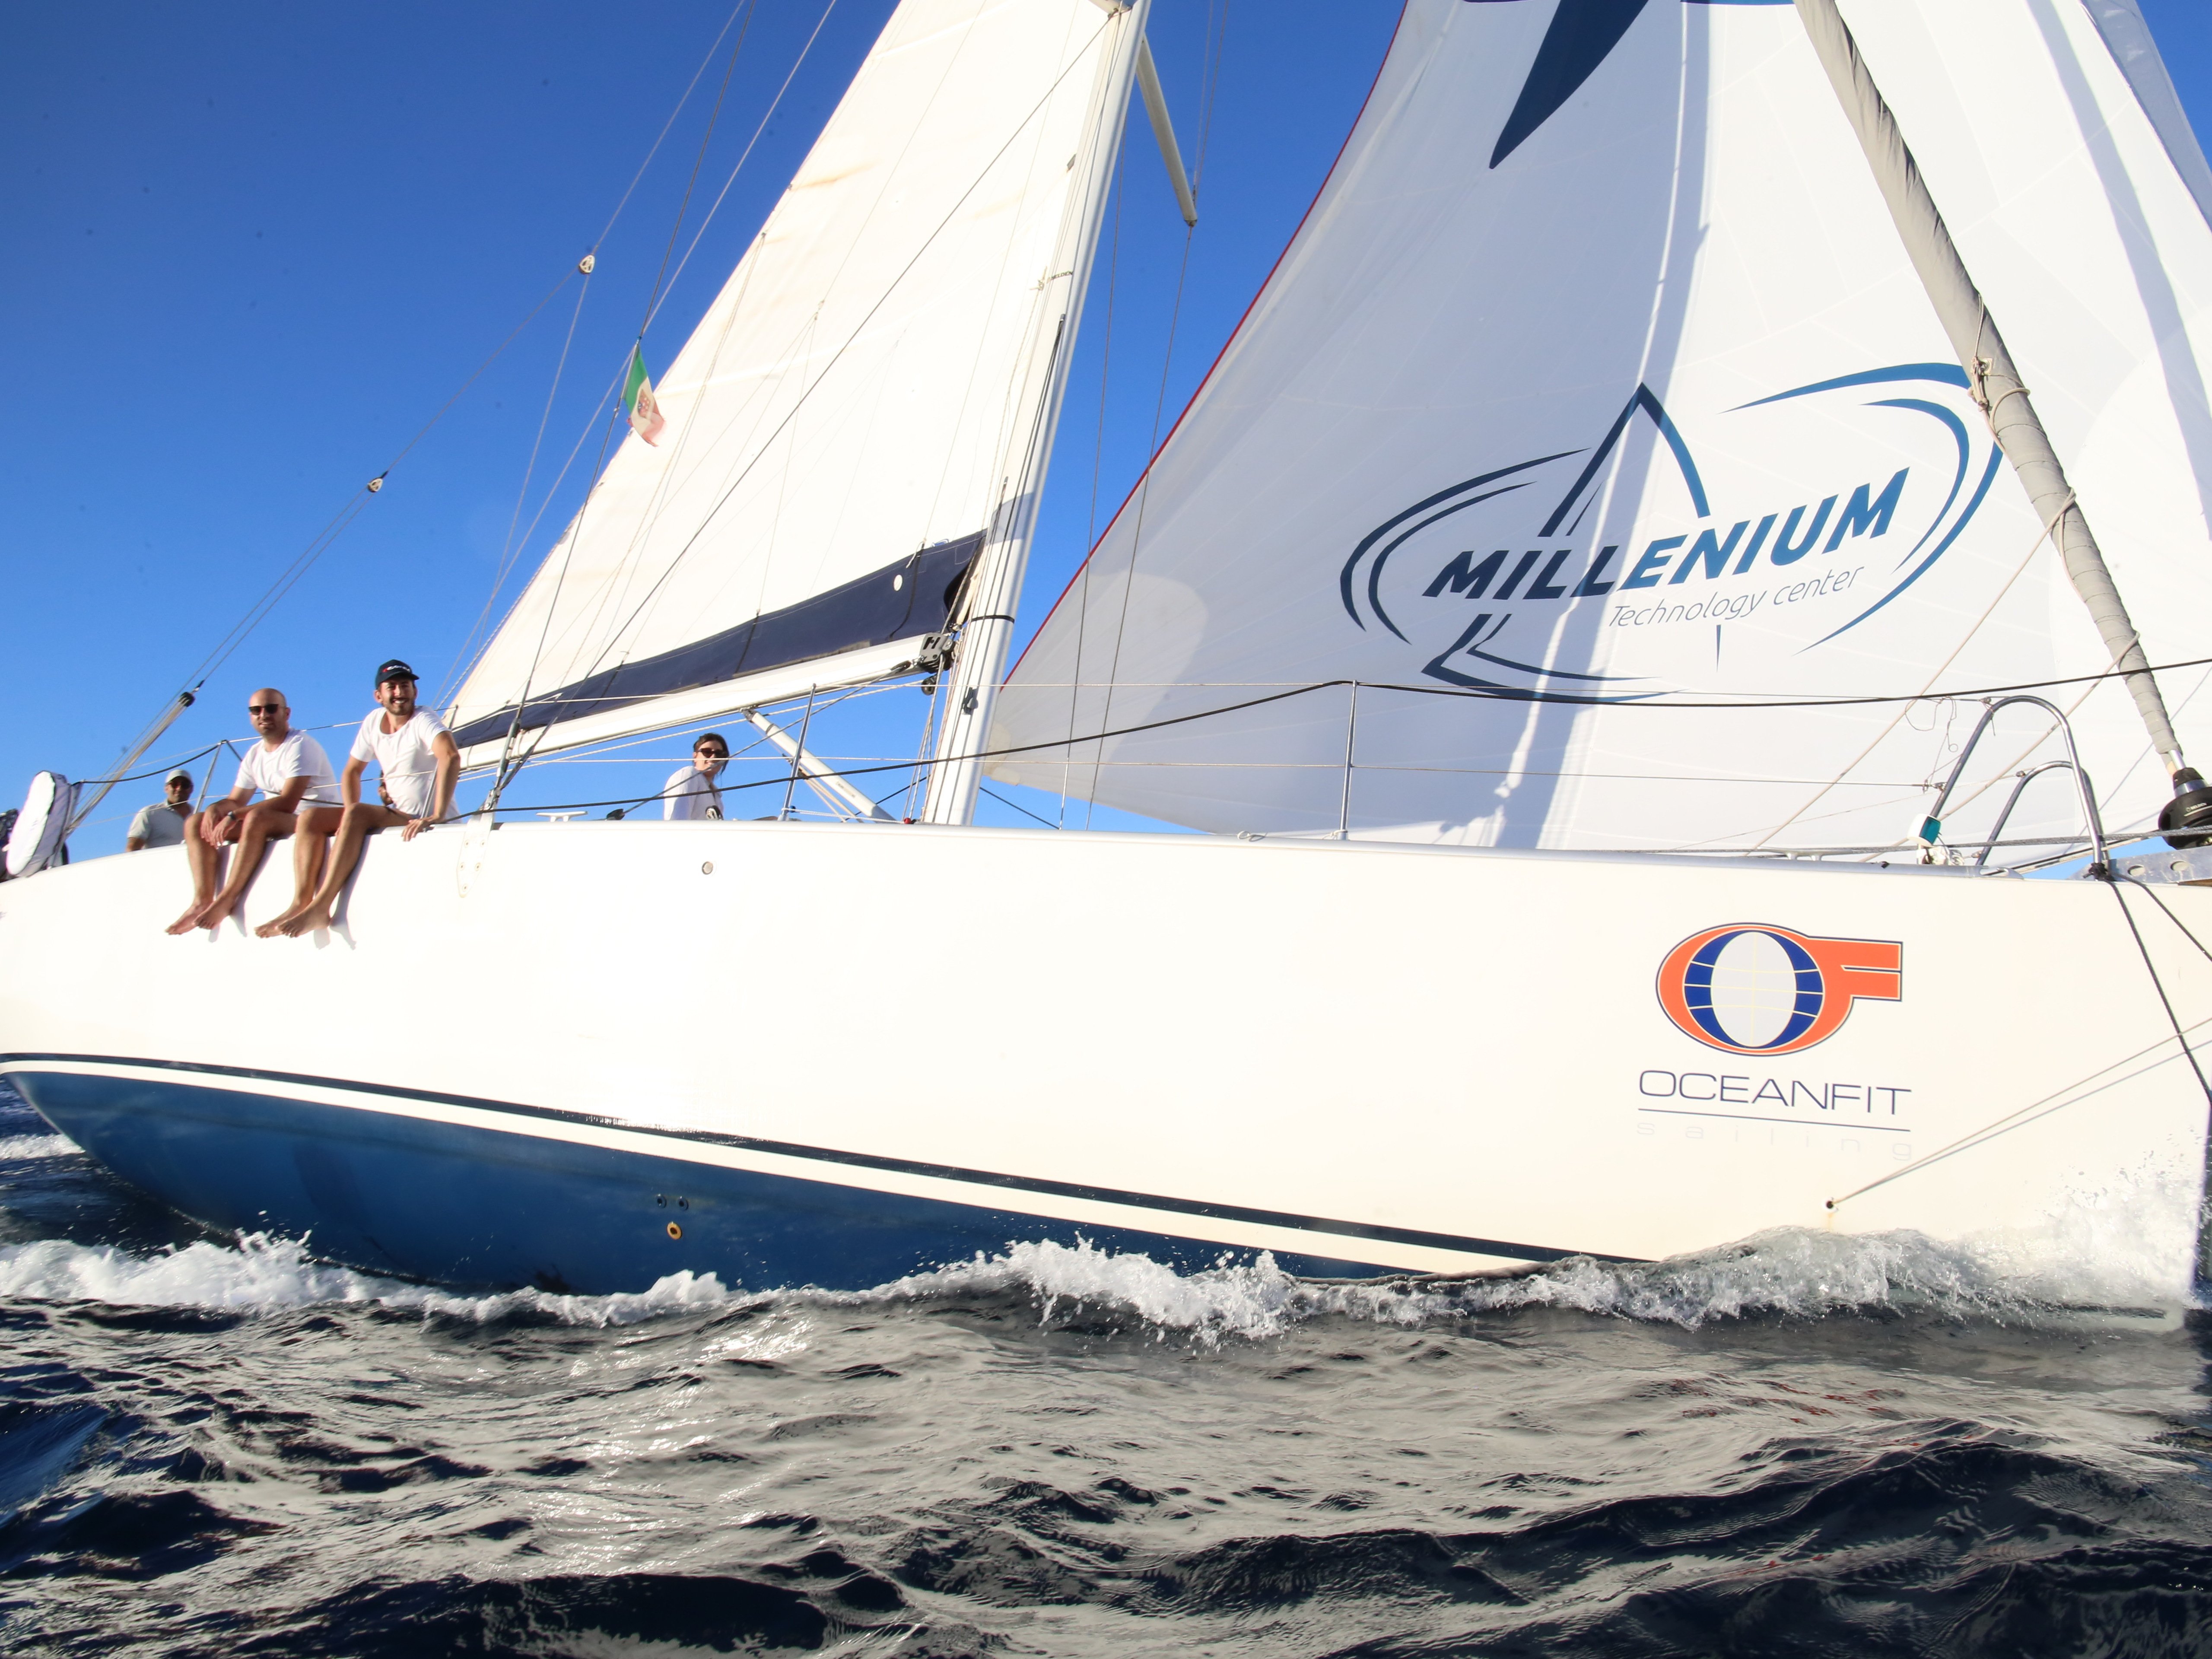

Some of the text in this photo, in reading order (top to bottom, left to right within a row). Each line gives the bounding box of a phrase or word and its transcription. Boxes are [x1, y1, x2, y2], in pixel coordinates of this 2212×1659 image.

[1421, 467, 1910, 600] MILLENIUM
[1609, 566, 1865, 627] Technology center
[1639, 1070, 1912, 1115] OCEANFIT
[1636, 1122, 1912, 1161] sailing
